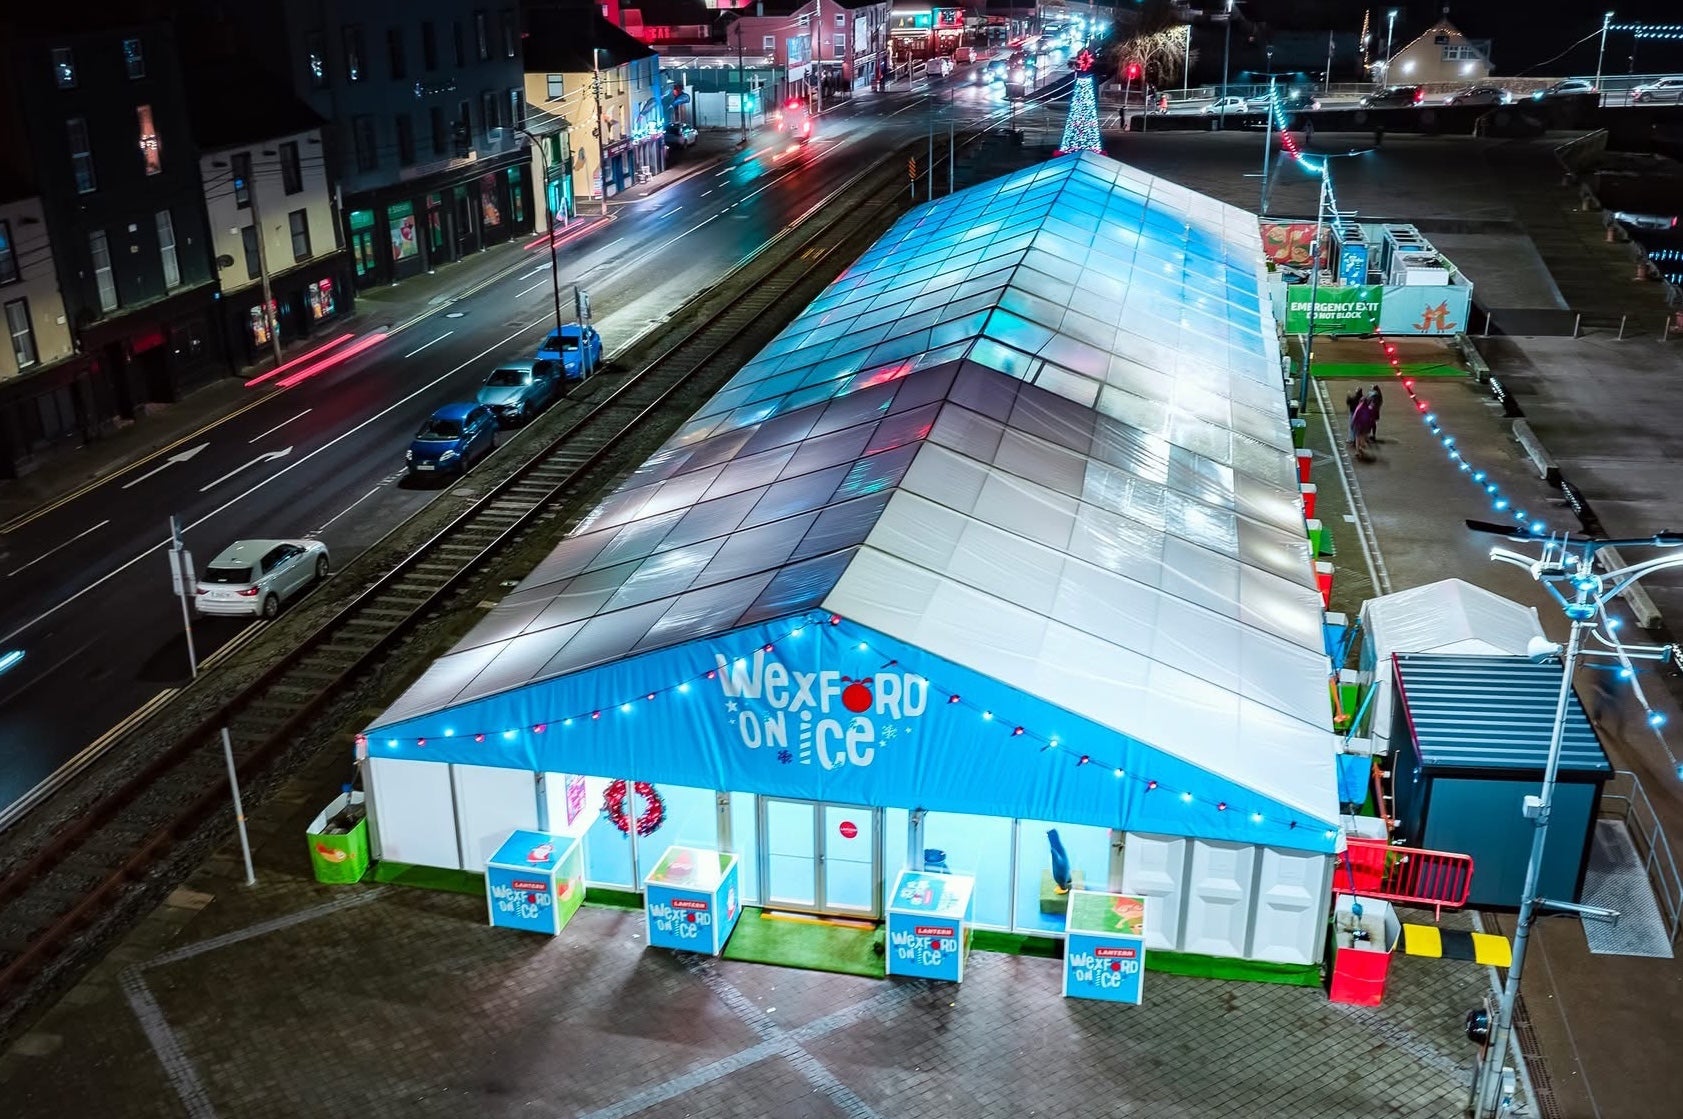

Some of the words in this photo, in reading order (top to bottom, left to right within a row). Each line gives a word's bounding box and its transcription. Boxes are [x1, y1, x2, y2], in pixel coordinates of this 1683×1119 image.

[1290, 302, 1355, 312] EMERGENCY
[1356, 302, 1379, 311] EXIT
[1318, 312, 1336, 320] NOT
[739, 711, 788, 749] ON
[499, 900, 514, 912] ON
[656, 920, 672, 931] ON
[898, 948, 914, 959] ON
[1076, 969, 1092, 981] ON
